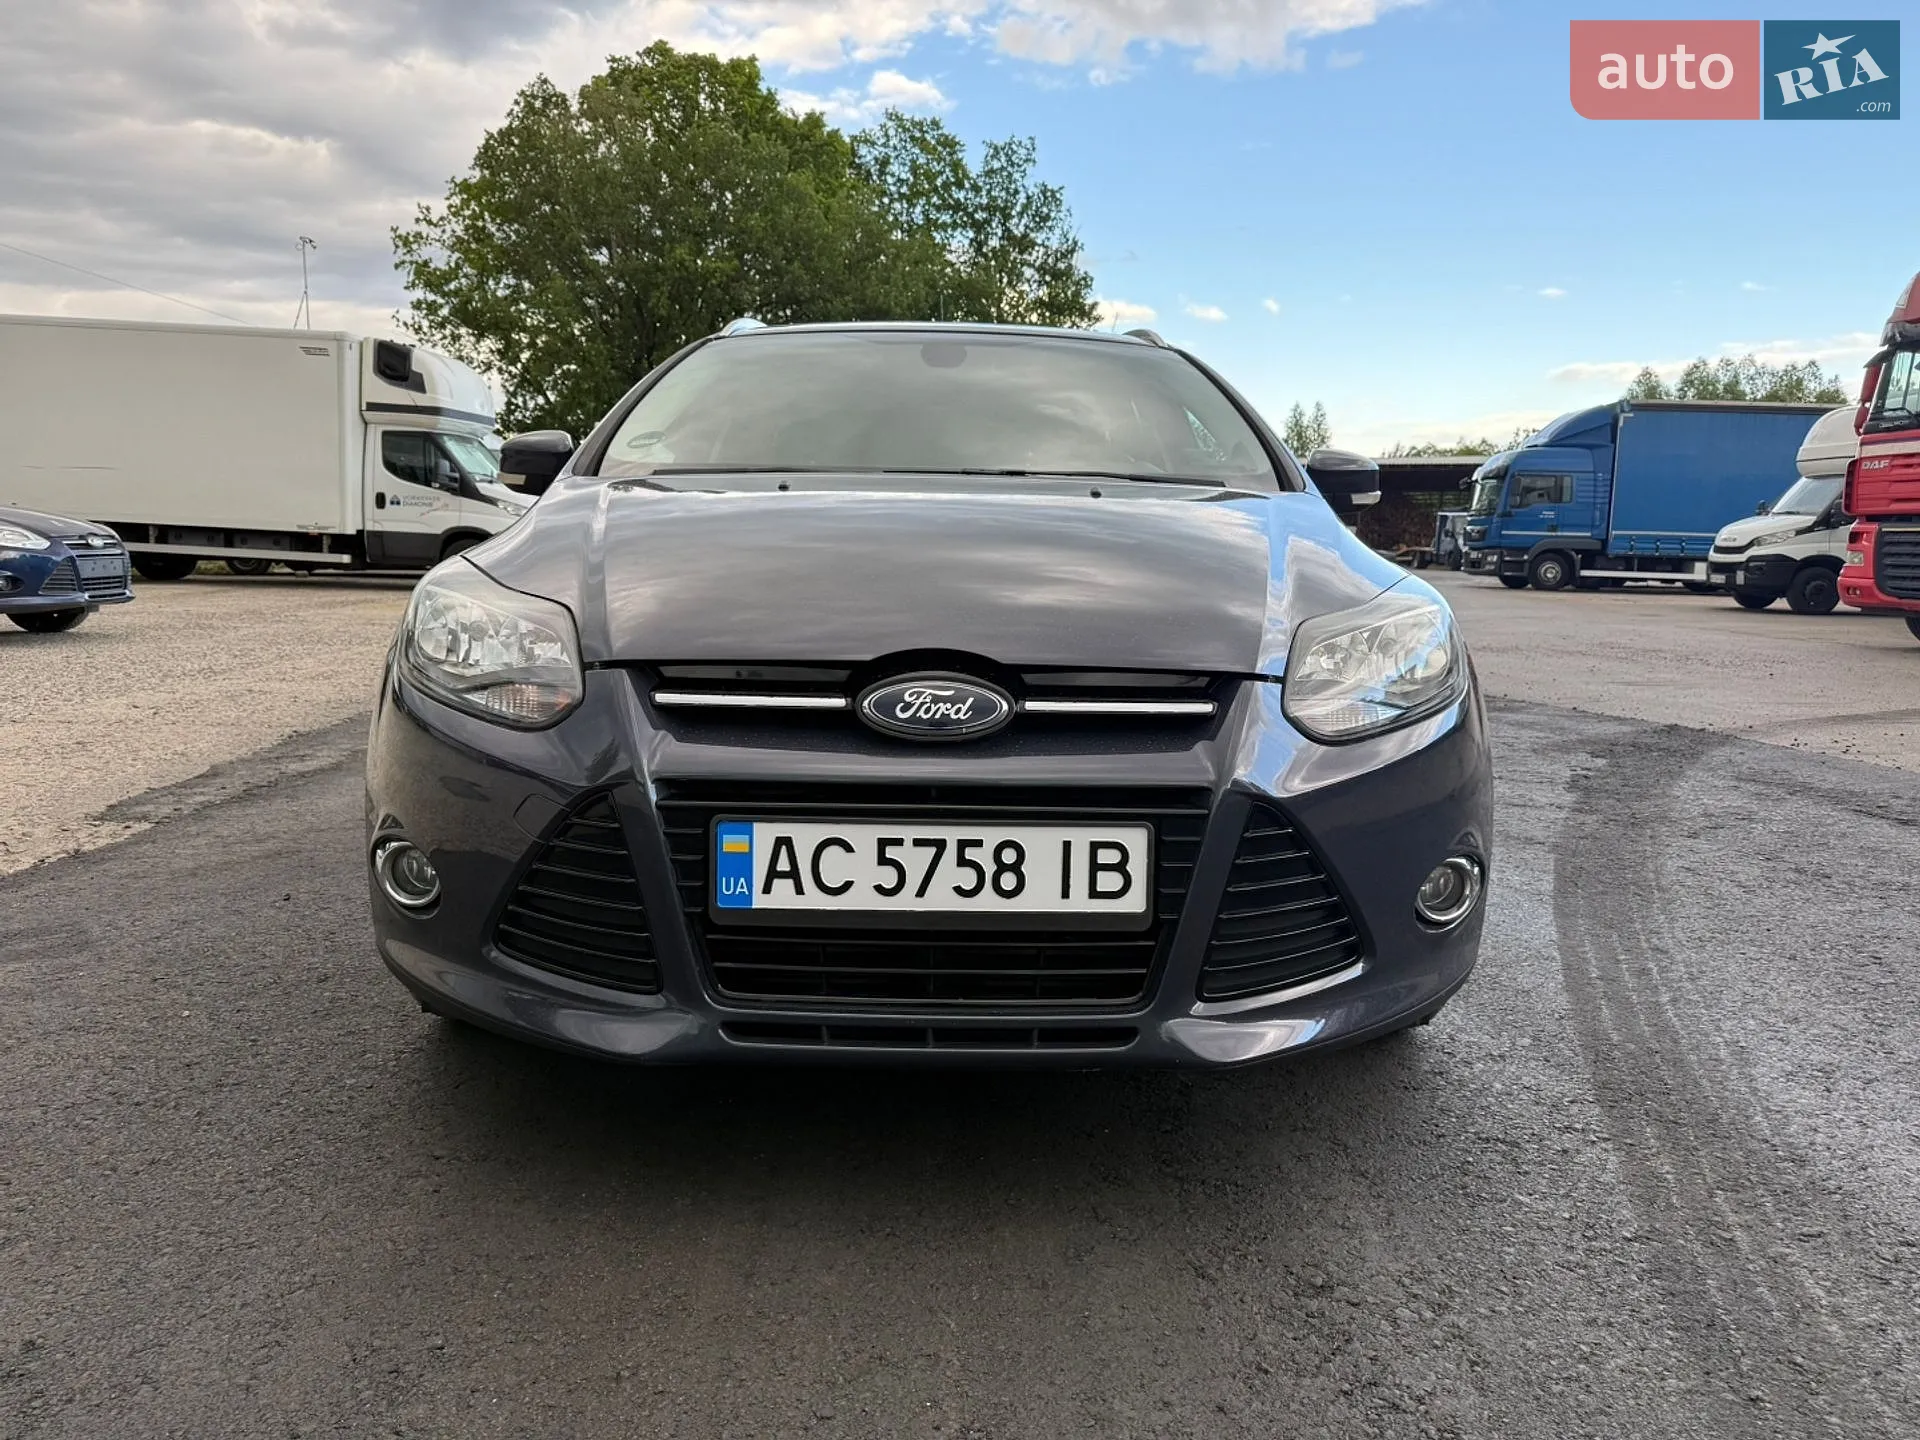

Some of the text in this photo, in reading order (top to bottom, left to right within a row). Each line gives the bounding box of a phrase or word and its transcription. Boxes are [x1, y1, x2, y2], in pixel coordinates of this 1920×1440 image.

[1862, 460, 1889, 469] DAF
[895, 687, 975, 720] Ford
[762, 836, 1133, 900] AC 5758 IB
[722, 876, 749, 895] UA
